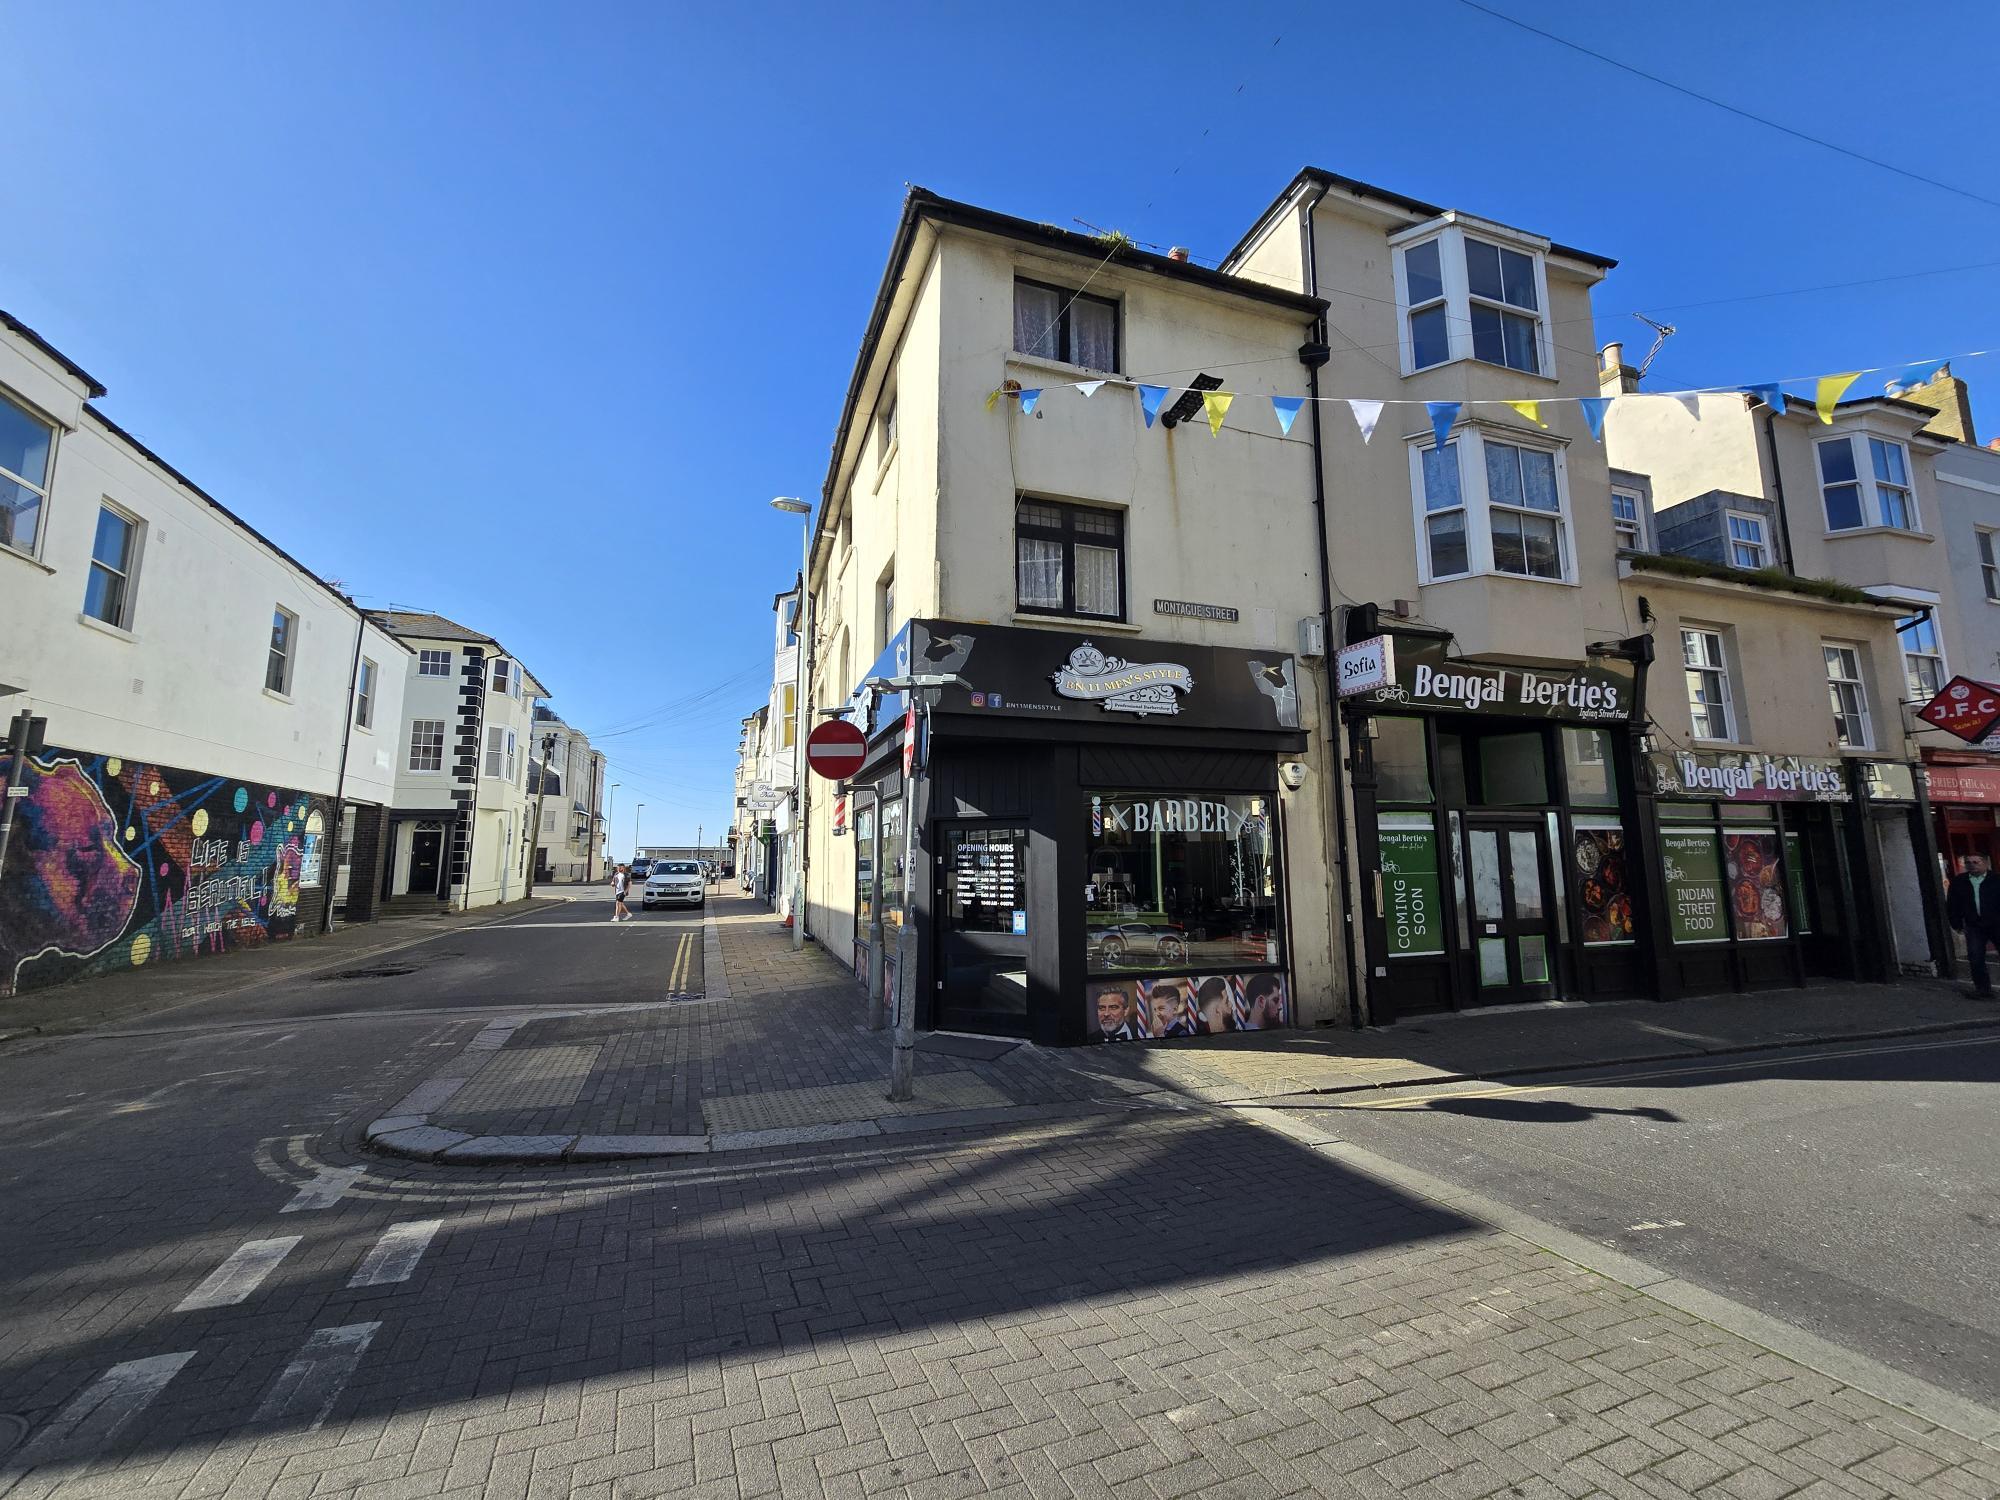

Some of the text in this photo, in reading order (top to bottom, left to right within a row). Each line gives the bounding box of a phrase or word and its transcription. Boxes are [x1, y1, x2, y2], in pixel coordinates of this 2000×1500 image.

[1156, 600, 1237, 620] MONTAGUE STREET
[1343, 656, 1377, 680] Sofia
[1065, 681, 1084, 692] BN
[1104, 674, 1142, 692] MEN'S
[1143, 668, 1182, 681] STYLE
[1413, 664, 1618, 710] Bengal Bertie's
[1579, 708, 1629, 720] Indian Street Food
[1684, 759, 1842, 798] Bengal Bertie's
[1932, 777, 1959, 789] FRIED
[1959, 778, 1997, 791] CHICKEN
[1132, 800, 1230, 832] BARBER
[957, 843, 1014, 852] OPENING HOURS
[1378, 834, 1428, 845] Bengal Bertie's
[1665, 838, 1711, 850] Bengal Bertie's
[190, 837, 251, 869] LIFE IS
[1676, 887, 1715, 901] INDIAN
[1393, 879, 1411, 949] COMING
[1411, 887, 1426, 936] SOON
[1678, 902, 1717, 916] STREET
[1684, 917, 1714, 931] FOOD
